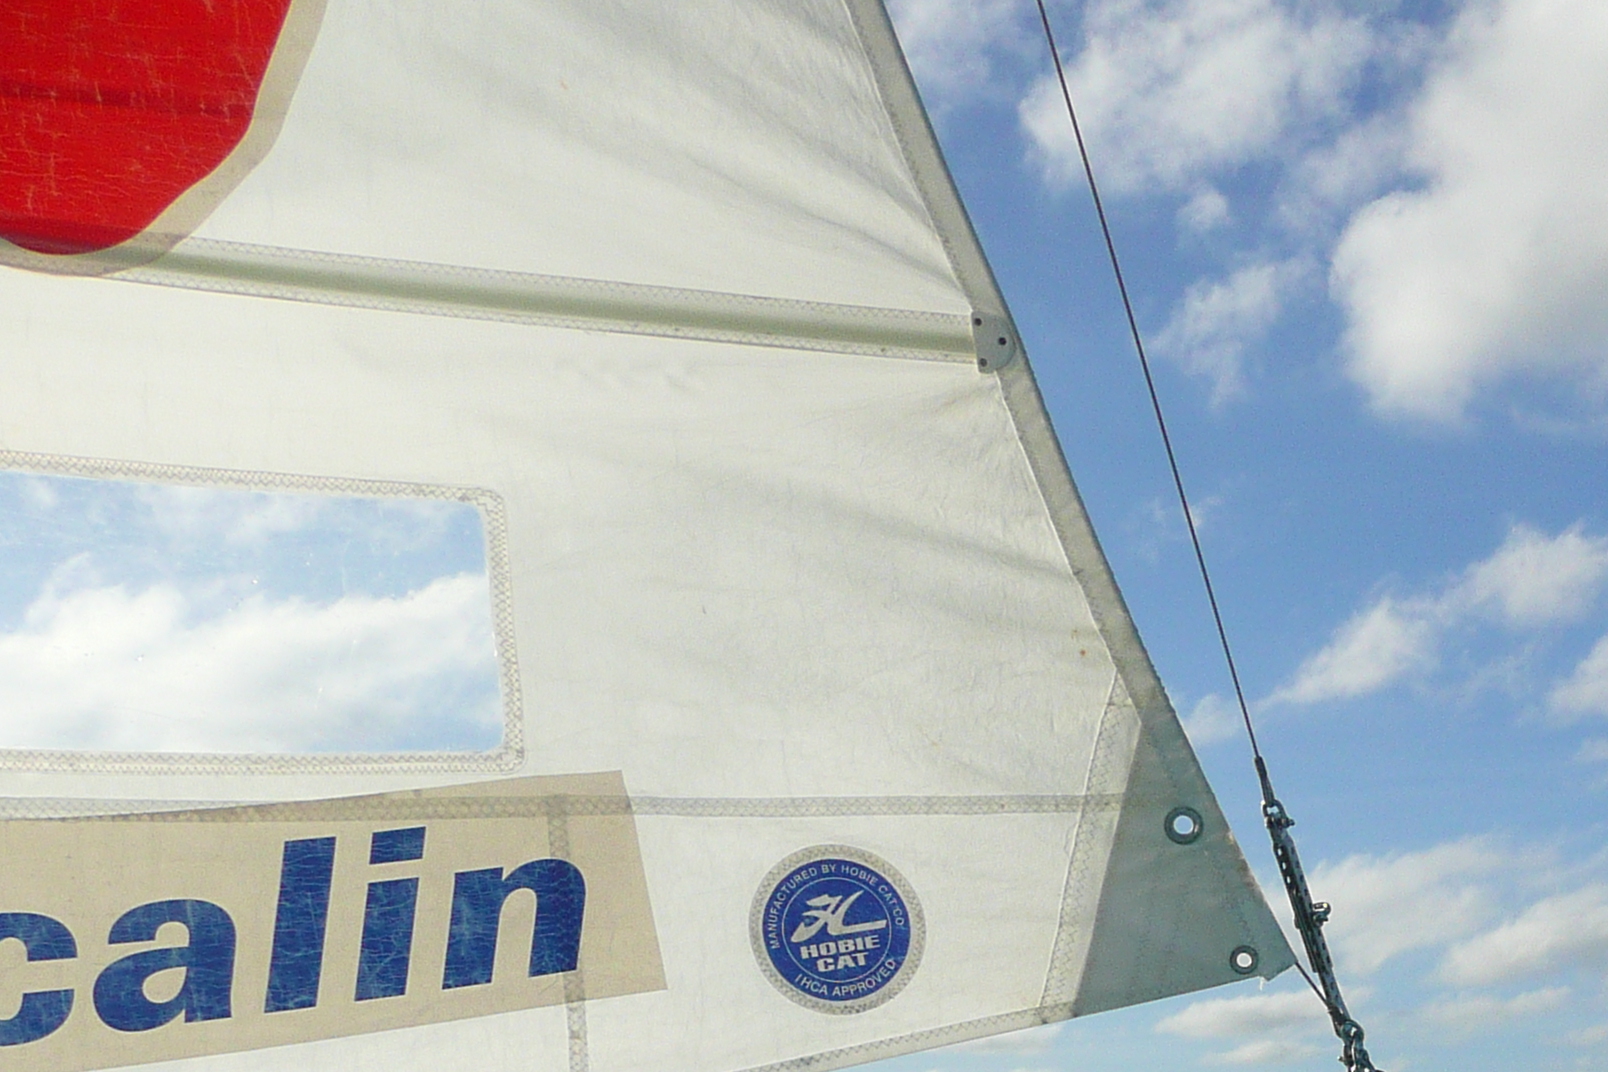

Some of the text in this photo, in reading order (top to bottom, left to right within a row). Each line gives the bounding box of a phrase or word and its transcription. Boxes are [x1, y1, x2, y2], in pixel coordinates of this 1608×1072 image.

[768, 867, 818, 949] MANUFACTURED
[821, 864, 837, 874] BY
[841, 865, 879, 886] HOBIE
[878, 885, 898, 905] CAT
[800, 935, 880, 960] HOBIE
[816, 952, 869, 972] CAT
[832, 959, 896, 997] APPROVED
